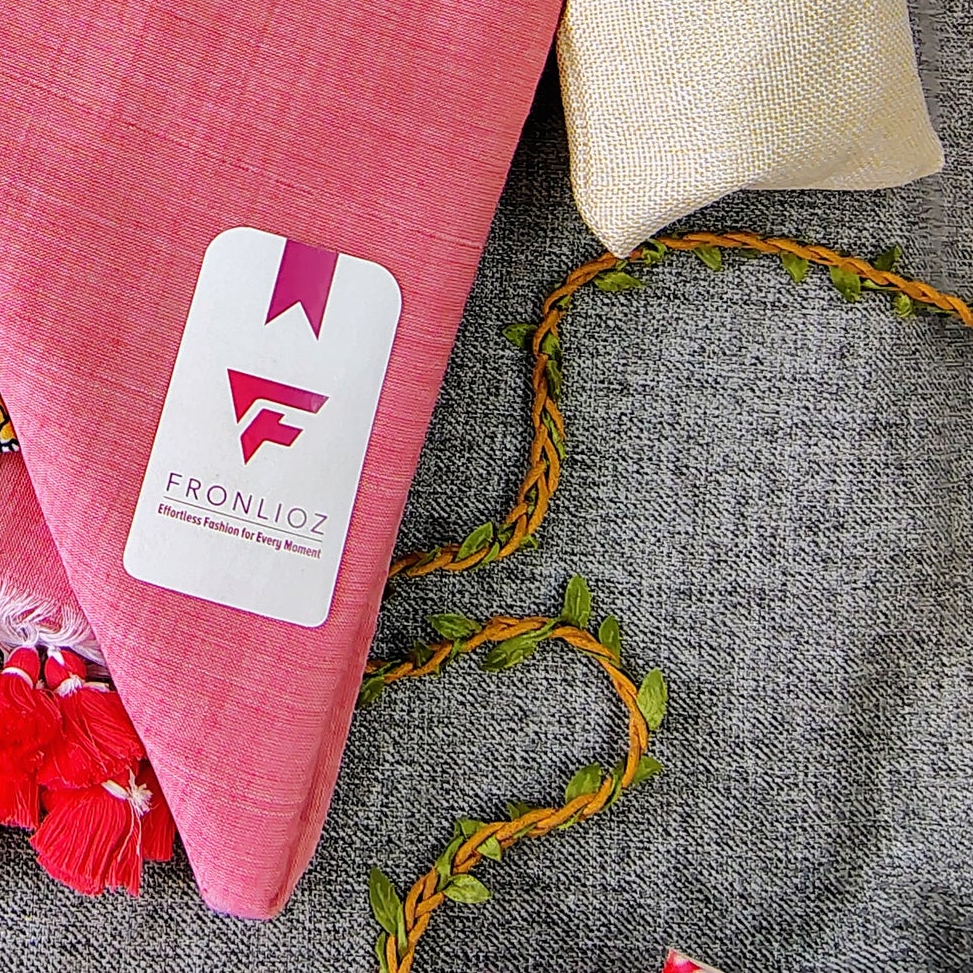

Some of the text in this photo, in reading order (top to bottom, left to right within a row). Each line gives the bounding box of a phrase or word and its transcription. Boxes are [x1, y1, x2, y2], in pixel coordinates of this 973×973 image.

[158, 504, 322, 559] Effortless Fashion for Every Moment
[166, 473, 328, 535] FRONLIOZ
